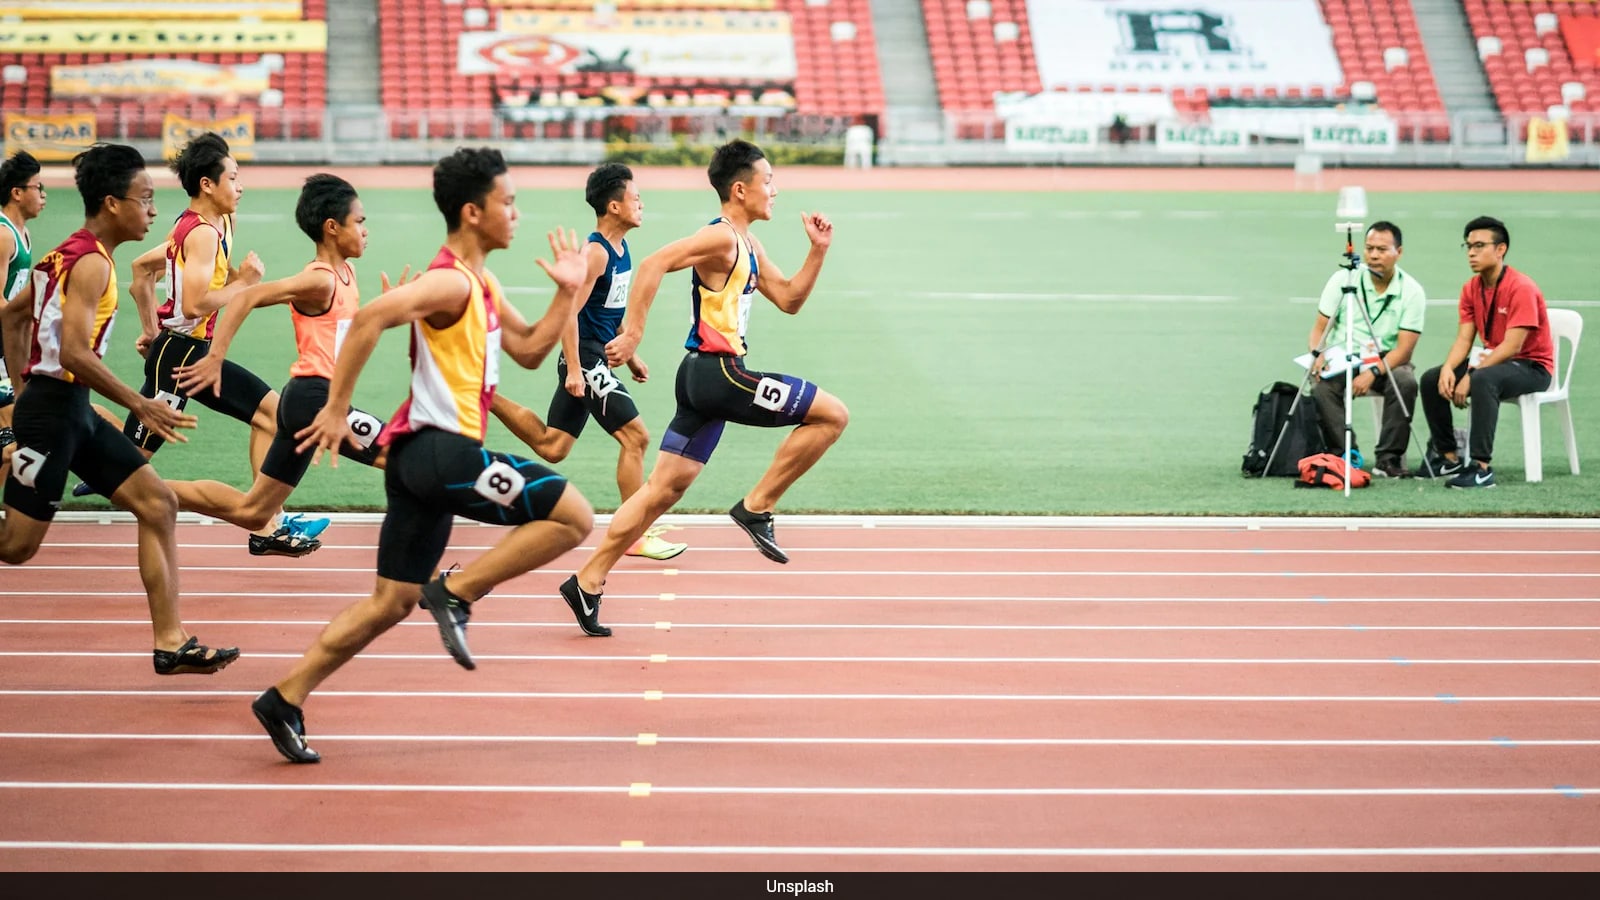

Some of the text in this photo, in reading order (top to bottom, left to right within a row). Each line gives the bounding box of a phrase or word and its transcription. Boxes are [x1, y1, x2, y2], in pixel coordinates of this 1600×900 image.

[1108, 9, 1252, 55] R
[10, 122, 92, 140] CEDAR
[168, 122, 249, 141] CEAR
[593, 372, 611, 391] 2
[761, 384, 782, 404] 5
[351, 419, 372, 437] 6
[18, 453, 36, 477] 7
[488, 472, 512, 495] 8
